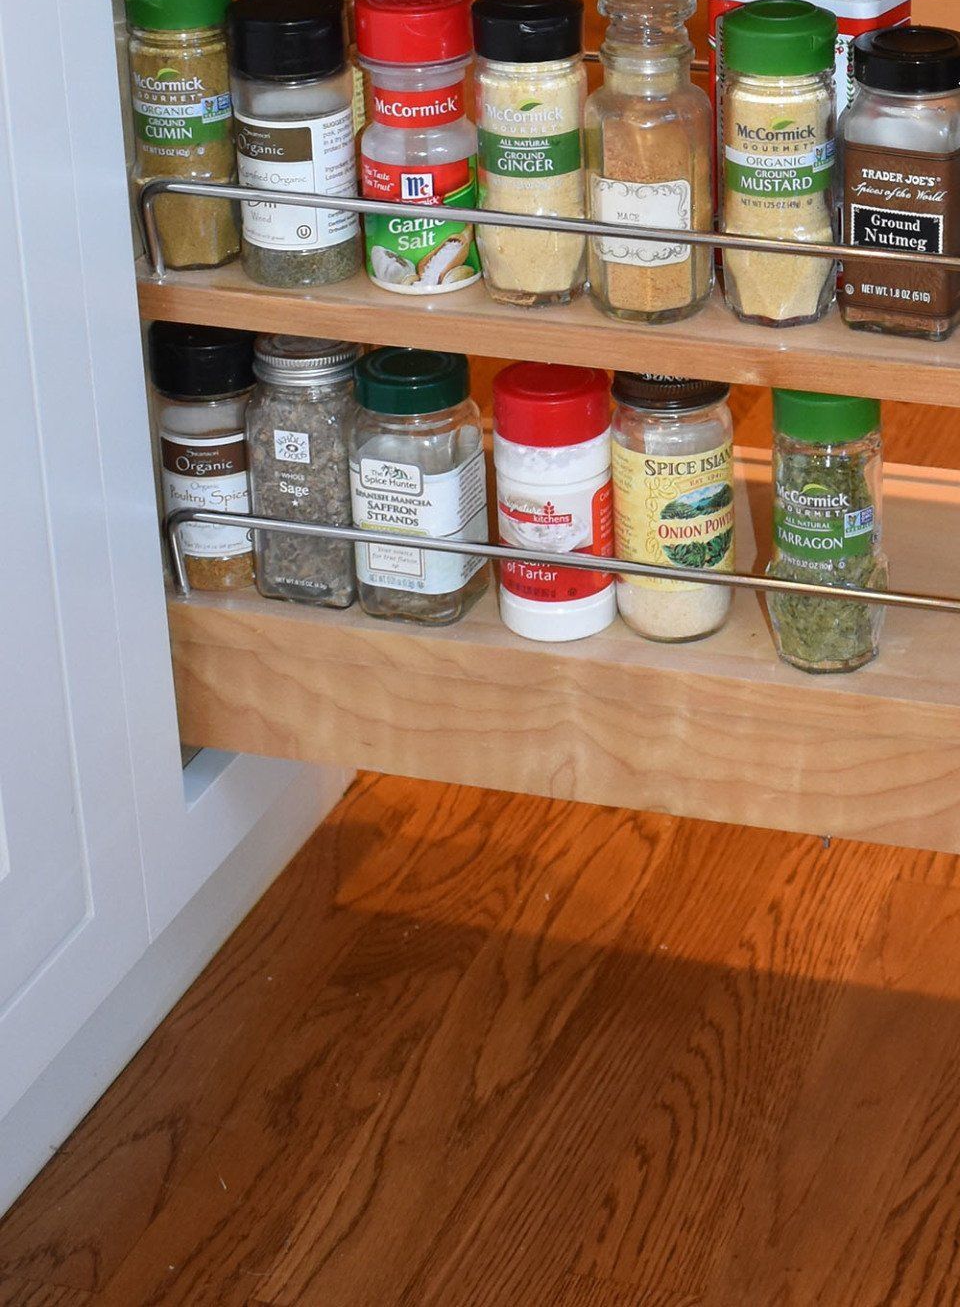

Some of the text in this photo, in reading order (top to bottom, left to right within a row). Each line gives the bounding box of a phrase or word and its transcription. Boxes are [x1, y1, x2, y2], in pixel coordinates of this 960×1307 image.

[134, 72, 205, 91] McCormick
[141, 103, 194, 116] ORGANIC
[374, 95, 457, 118] McCormick
[485, 104, 564, 122] McCormick
[148, 117, 185, 127] GROUND
[145, 125, 193, 139] CUMIN
[735, 122, 816, 142] McCormick
[238, 133, 285, 157] Organic
[500, 138, 550, 147] ALL NATURAL
[742, 142, 809, 153] GOURMET
[504, 151, 545, 160] GROUND
[746, 155, 807, 167] ORGANIC
[497, 158, 554, 172] GINGER
[755, 169, 797, 179] GROUND
[861, 168, 903, 183] TRADER
[740, 176, 813, 192] MUSTARD
[851, 181, 948, 202] Spices of the World
[617, 212, 640, 222] MACE
[870, 213, 921, 232] Ground
[398, 231, 436, 252] Salt
[864, 227, 928, 252] Nutmeg
[861, 283, 875, 294] NET
[890, 287, 901, 298] 1.8
[901, 288, 911, 299] OZ
[912, 290, 931, 304] (51G)
[175, 455, 234, 475] Organic
[644, 444, 732, 476] SPICE ISLAN
[280, 481, 310, 497] Sage
[365, 475, 417, 490] Spice Hunter
[169, 484, 205, 508] Poultry
[356, 488, 432, 507] SPANISH MANCHA
[776, 481, 850, 507] McCormick
[367, 500, 417, 516] SAFFRON
[367, 511, 419, 526] STRANDS
[533, 514, 570, 523] kitchens
[785, 516, 830, 529] ALL NATURAL
[658, 524, 702, 539] ONION
[777, 526, 844, 550] TARRAGON
[507, 561, 515, 573] of
[518, 564, 557, 581] Tartar
